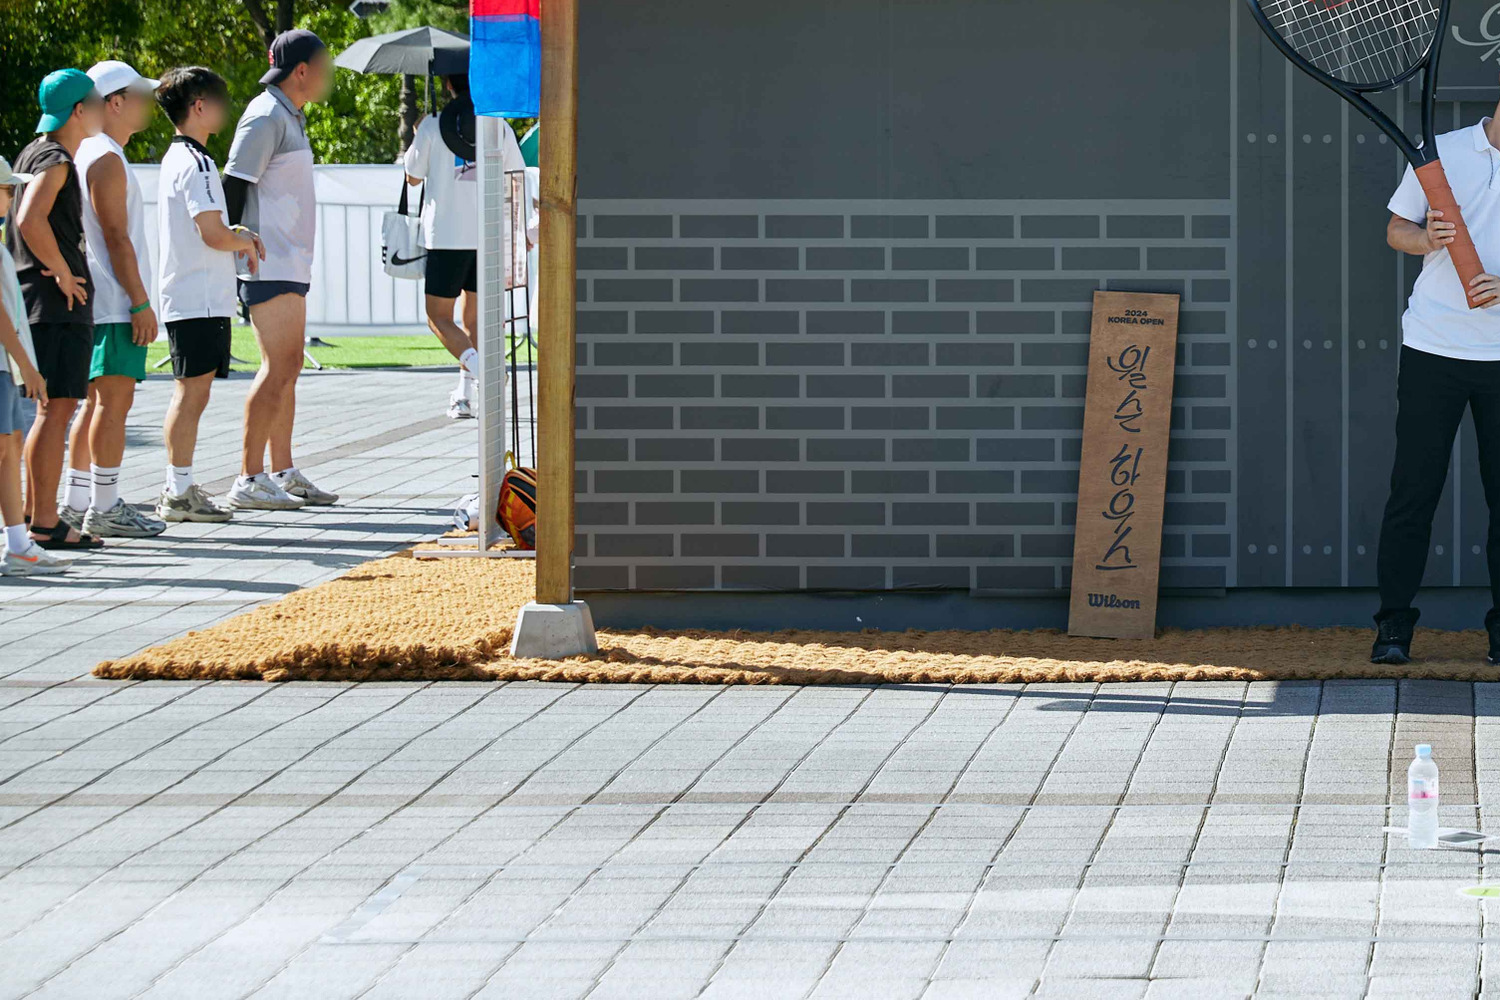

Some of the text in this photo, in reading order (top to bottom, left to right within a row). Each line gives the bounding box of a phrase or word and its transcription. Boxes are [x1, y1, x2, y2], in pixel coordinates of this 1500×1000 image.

[1124, 309, 1149, 317] 2024
[1107, 316, 1165, 326] KOREA OPEN
[1087, 593, 1141, 609] Wilson
